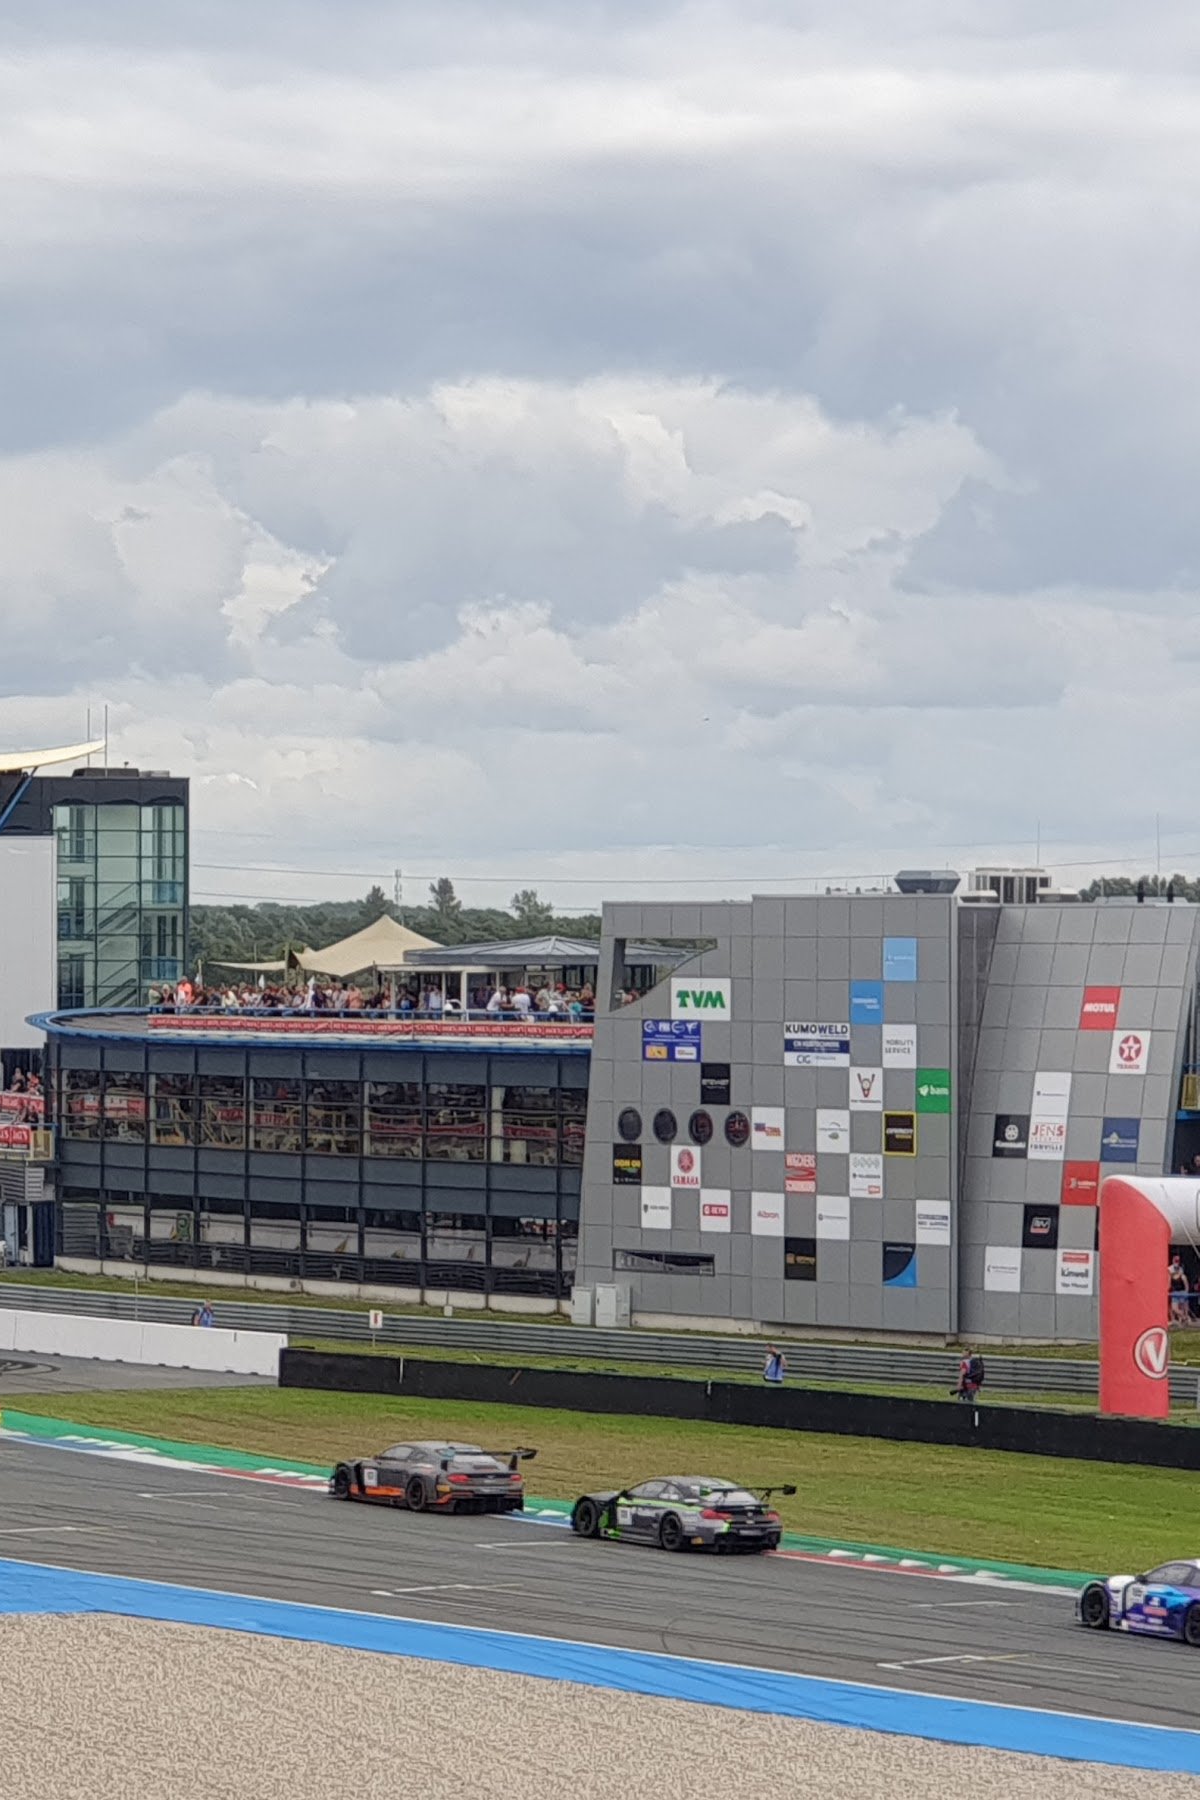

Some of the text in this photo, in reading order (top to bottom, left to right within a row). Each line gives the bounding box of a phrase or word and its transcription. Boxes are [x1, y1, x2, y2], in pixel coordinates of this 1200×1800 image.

[676, 990, 726, 1009] TVM
[1083, 1003, 1115, 1013] MOTUL
[785, 1024, 848, 1034] KUMOWELD
[930, 1085, 949, 1095] bam
[1032, 1124, 1064, 1137] JENS
[672, 1175, 699, 1186] YAMAHA
